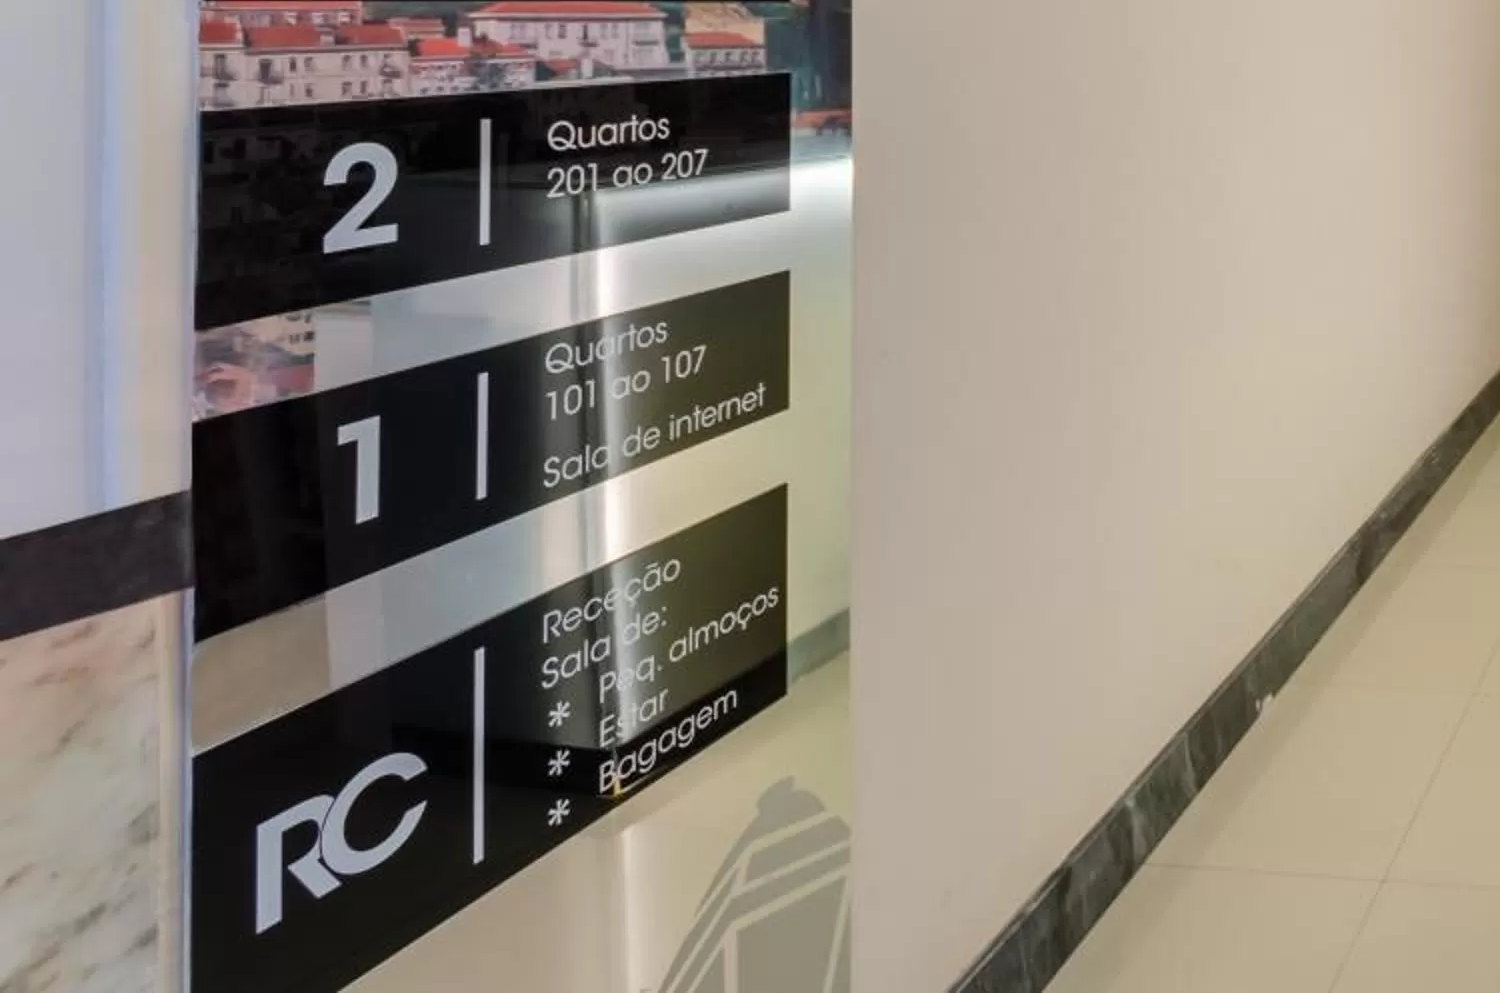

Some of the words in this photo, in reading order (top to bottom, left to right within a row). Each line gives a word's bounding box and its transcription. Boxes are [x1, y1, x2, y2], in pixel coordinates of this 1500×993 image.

[546, 163, 599, 198] 201
[612, 161, 652, 188] ao
[662, 148, 709, 180] 207
[547, 113, 670, 152] Quartos
[322, 142, 399, 254] 2
[544, 322, 668, 375] Quartos
[546, 380, 597, 421] 101
[611, 368, 650, 399] ao
[662, 346, 707, 383] 107
[337, 416, 381, 524] 1
[543, 444, 611, 488] Sala
[622, 416, 660, 459] de
[669, 383, 767, 440] internet
[542, 558, 681, 644] Receção
[541, 637, 610, 690] Sala
[623, 607, 667, 645] de:
[599, 661, 662, 704] Peq.
[668, 587, 779, 663] almoços
[599, 688, 738, 792] Bagagem
[600, 687, 667, 748] Estar
[255, 752, 428, 935] RC
